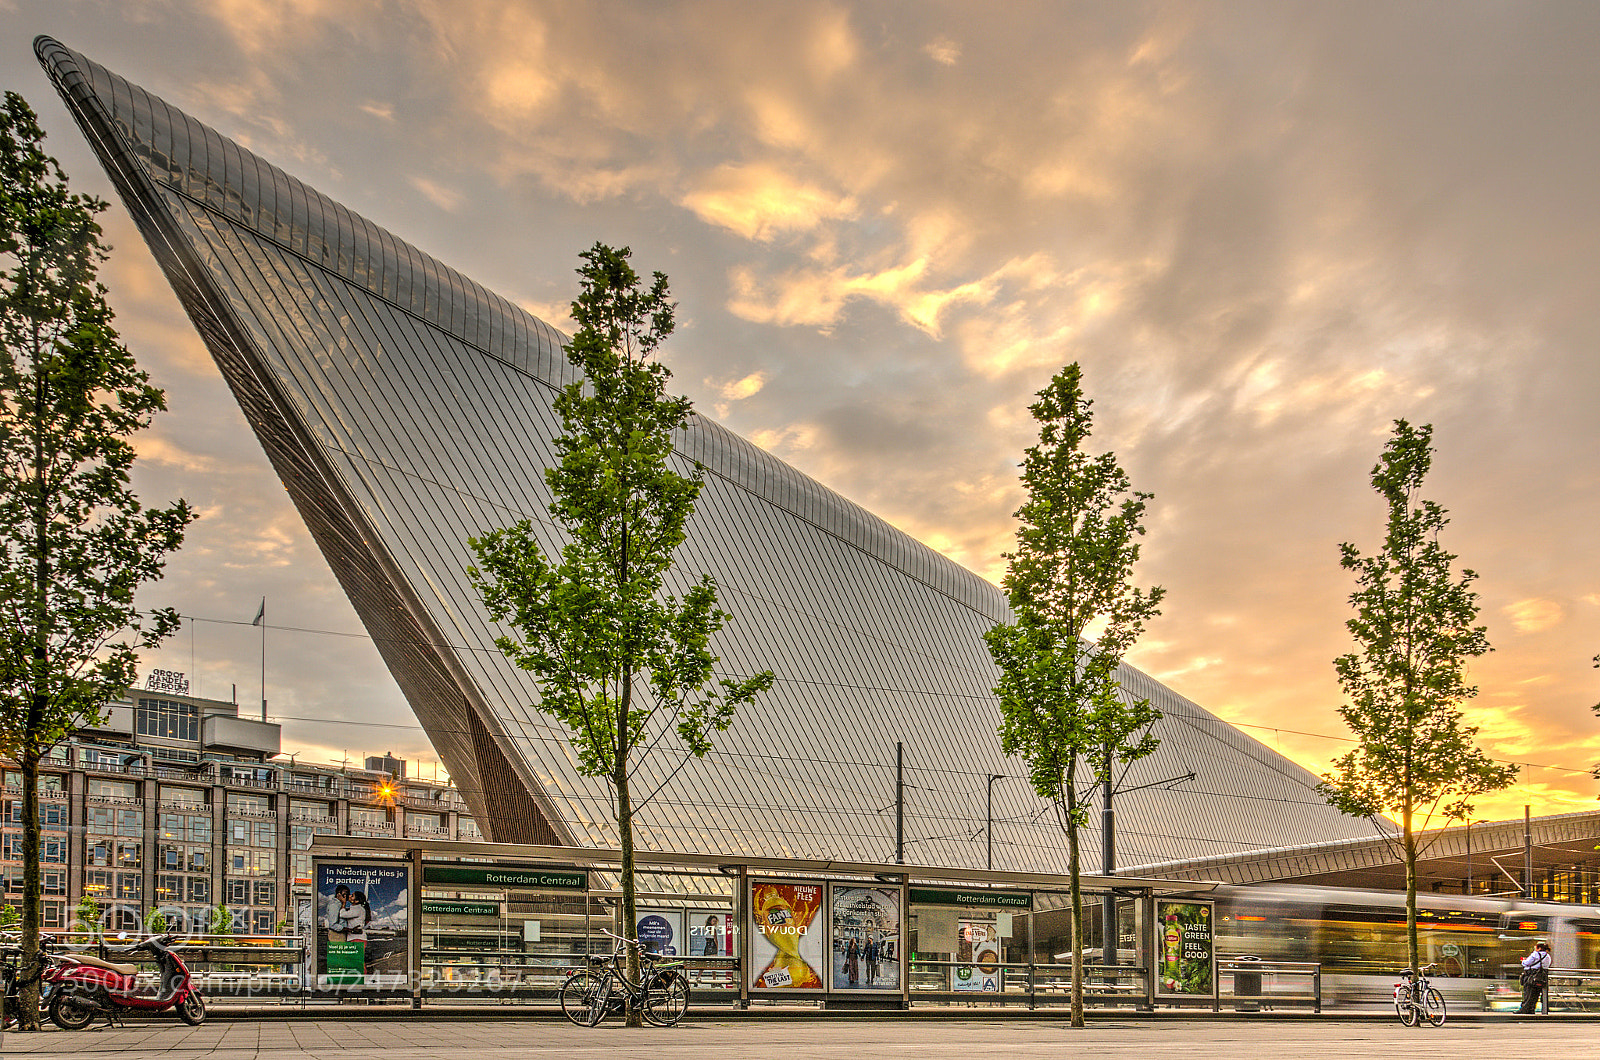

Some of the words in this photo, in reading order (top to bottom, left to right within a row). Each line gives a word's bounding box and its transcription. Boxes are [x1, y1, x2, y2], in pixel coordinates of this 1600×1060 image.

[153, 669, 184, 679] GROOT
[149, 674, 189, 687] HANDELS
[336, 868, 377, 877] Nederland
[396, 870, 404, 879] je
[325, 876, 334, 885] je
[336, 877, 364, 885] partner
[486, 873, 538, 884] Rotterdam
[540, 876, 580, 886] Centraal
[793, 885, 817, 894] NIEUWE
[797, 892, 813, 901] FLES
[957, 894, 996, 904] Rotterdam
[997, 896, 1028, 905] Centraal
[423, 904, 462, 913] Rotterdam
[463, 906, 494, 914] Centraal
[1184, 923, 1207, 931] TASTE
[1184, 931, 1210, 940] GREEN
[1184, 942, 1202, 950] FEEL
[1184, 951, 1209, 959] GOOD
